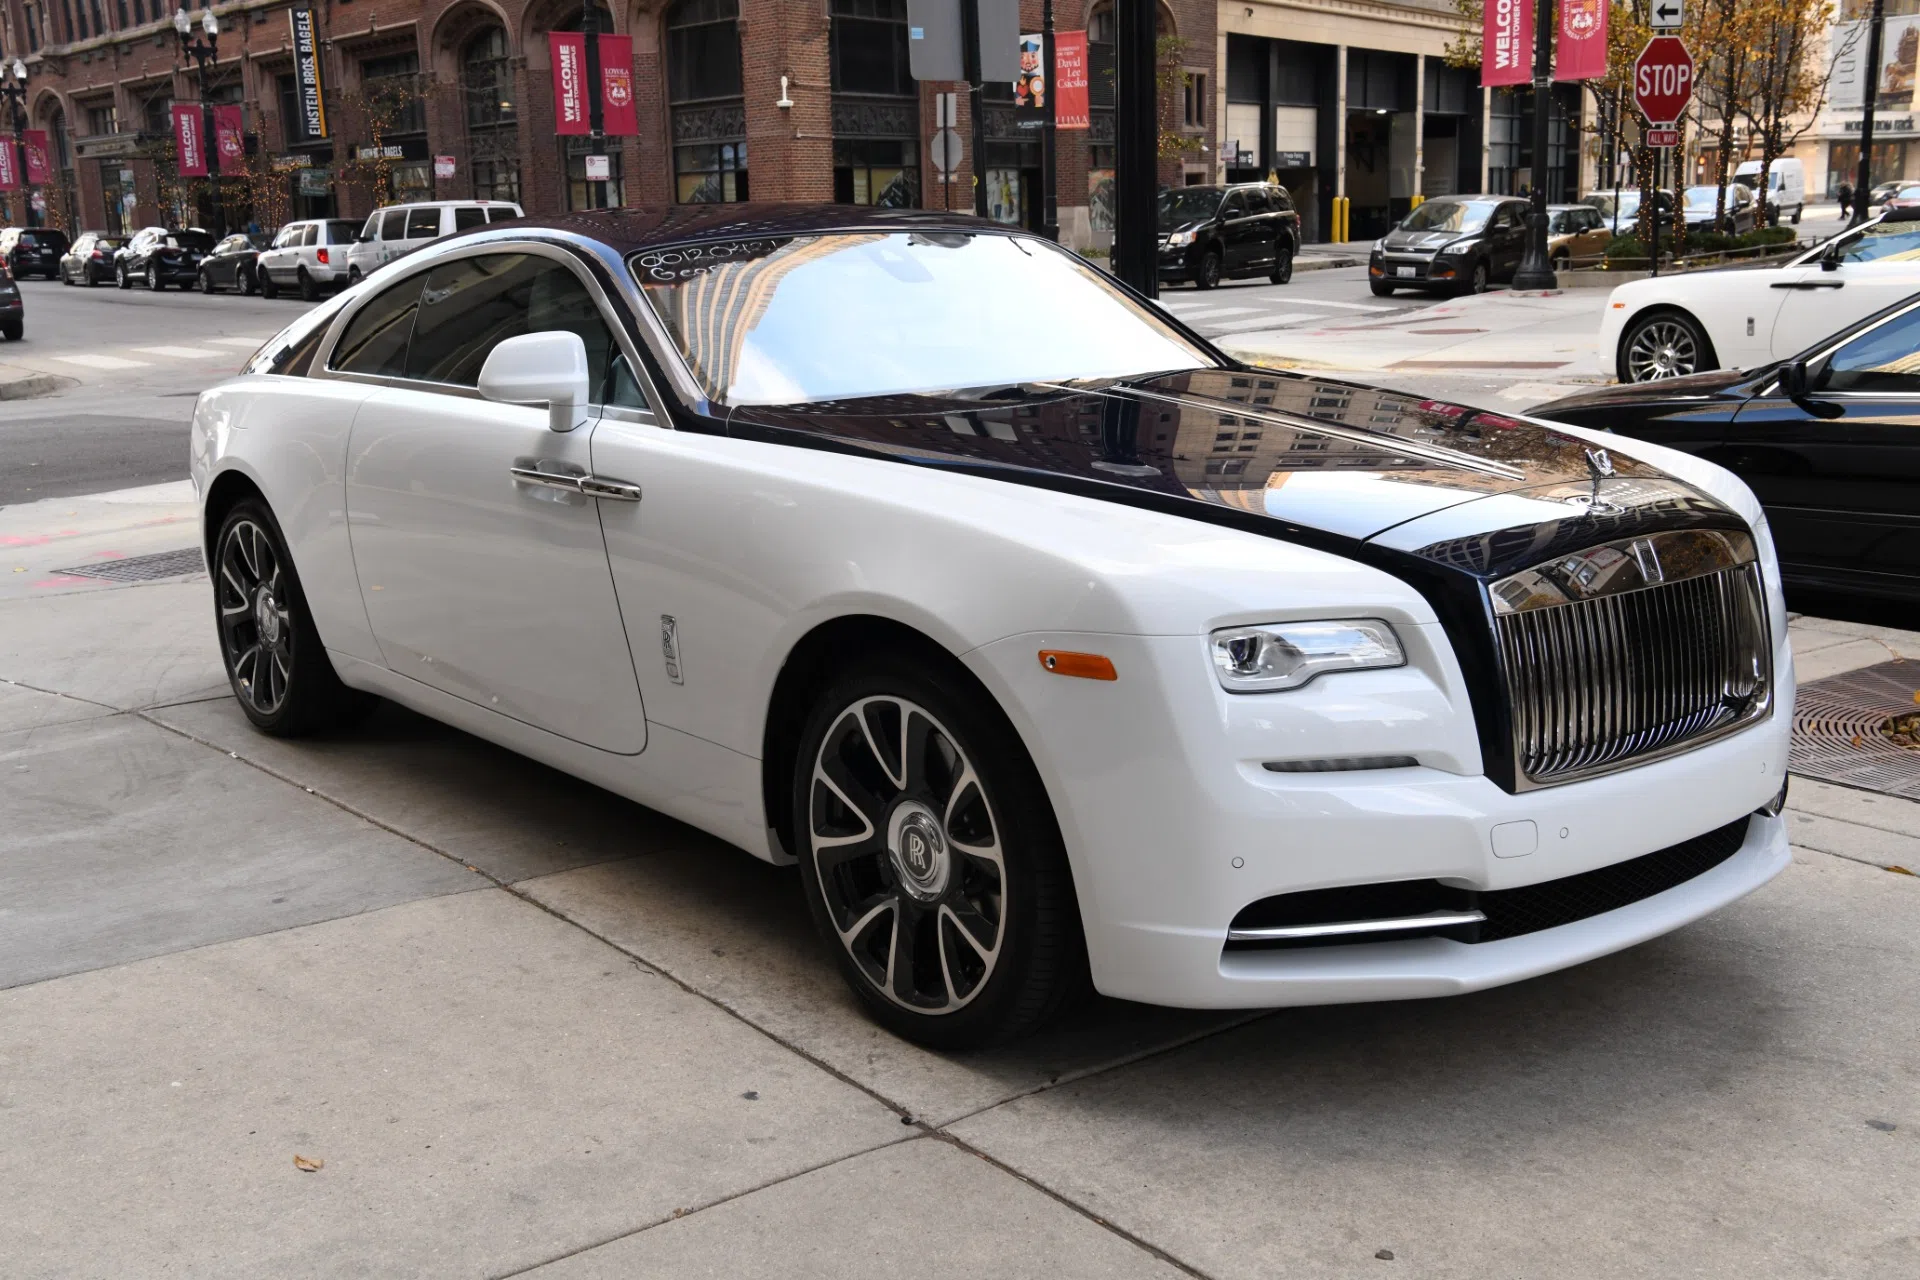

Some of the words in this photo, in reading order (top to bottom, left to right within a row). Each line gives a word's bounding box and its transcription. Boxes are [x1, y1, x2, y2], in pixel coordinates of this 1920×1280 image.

[296, 11, 313, 53] BAGELS
[1512, 5, 1520, 37] TOWER
[570, 45, 578, 74] CAMPUS
[1057, 57, 1080, 68] David
[1511, 38, 1519, 68] WATER
[559, 45, 575, 122] WELCOME
[1067, 68, 1080, 77] Lee
[1638, 64, 1690, 96] STOP
[304, 87, 321, 135] EINSTEIN
[573, 100, 581, 122] WATER
[1055, 114, 1089, 125] LUMA
[181, 114, 194, 168] WELCOME
[1650, 133, 1661, 143] ALL
[1662, 133, 1676, 143] WAY
